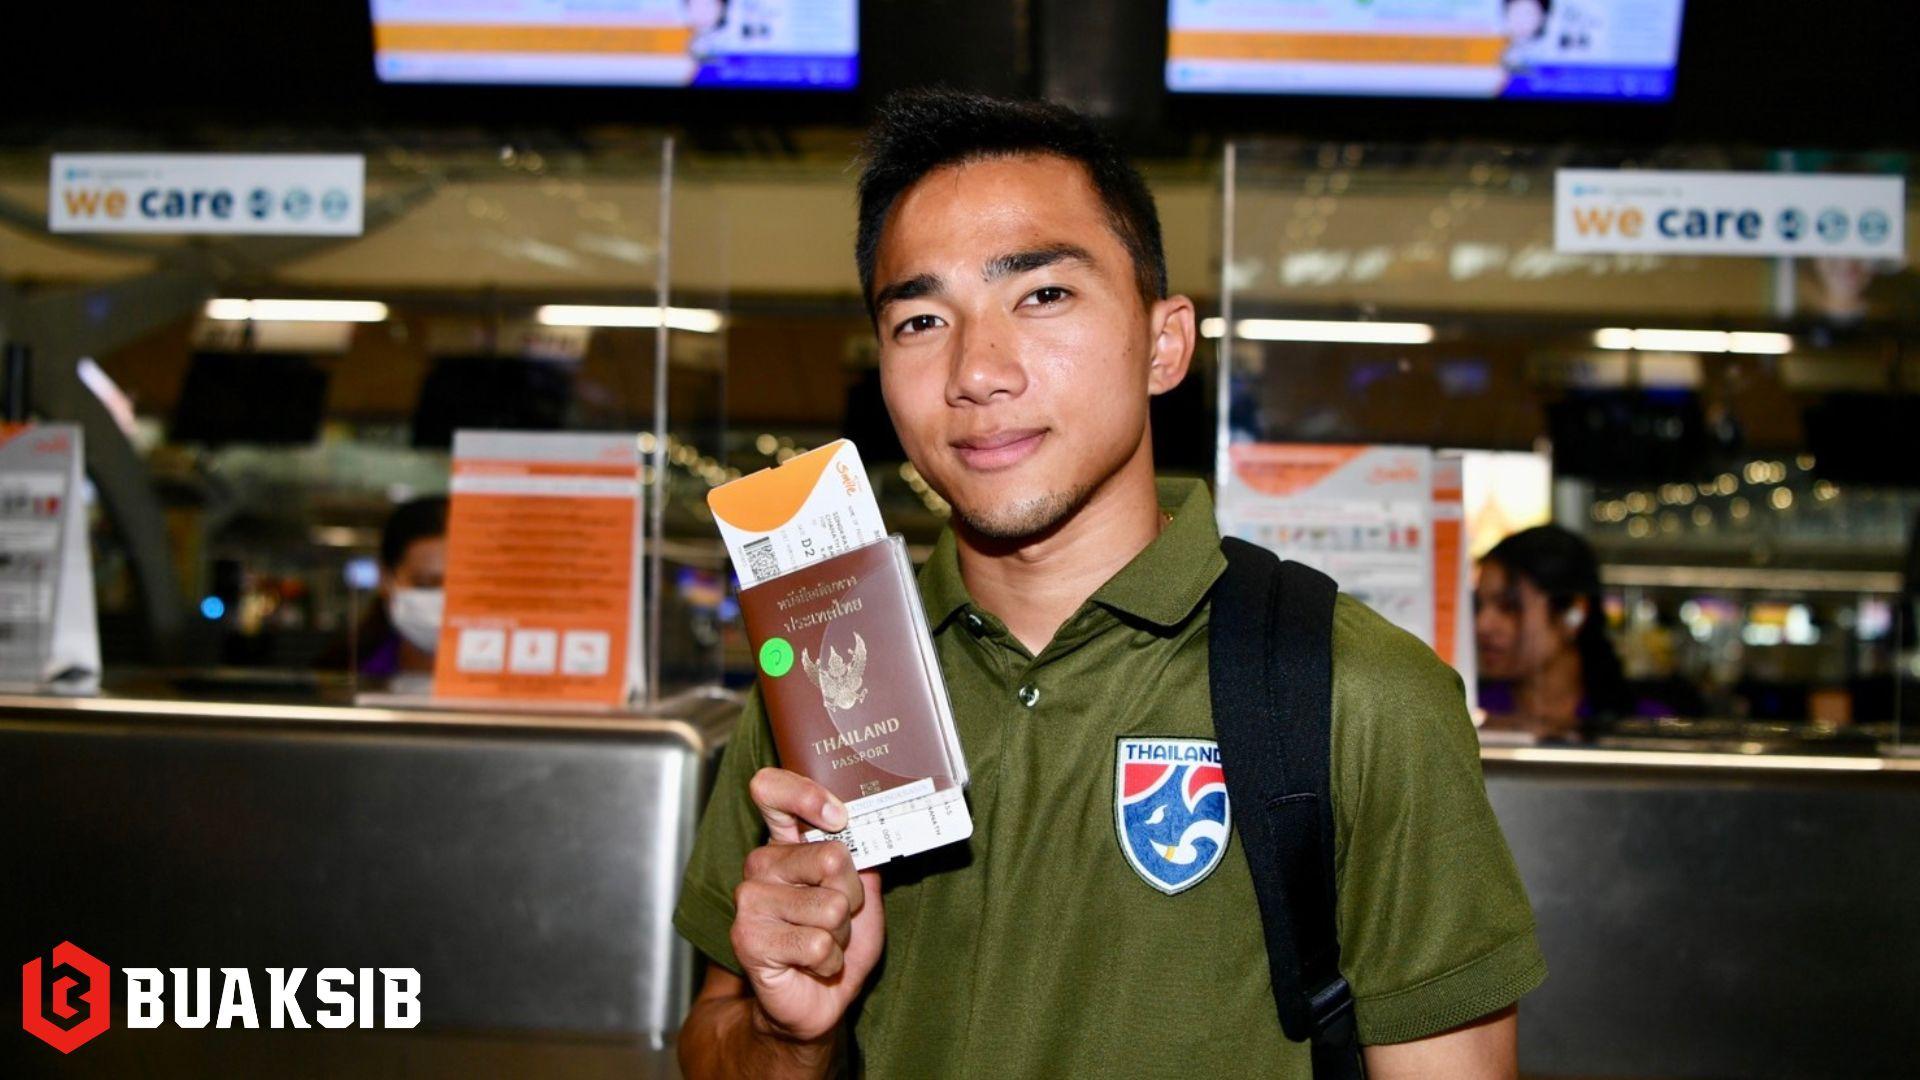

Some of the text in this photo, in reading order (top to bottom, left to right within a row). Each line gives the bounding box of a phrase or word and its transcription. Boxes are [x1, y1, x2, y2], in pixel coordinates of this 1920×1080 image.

[63, 187, 233, 219] we care
[1572, 207, 1762, 240] we care
[800, 537, 816, 558] D2
[784, 597, 863, 633] ประเทศไทย
[811, 717, 900, 756] THAILAND
[831, 744, 890, 770] PASSPORT
[1126, 744, 1221, 763] THAILAND
